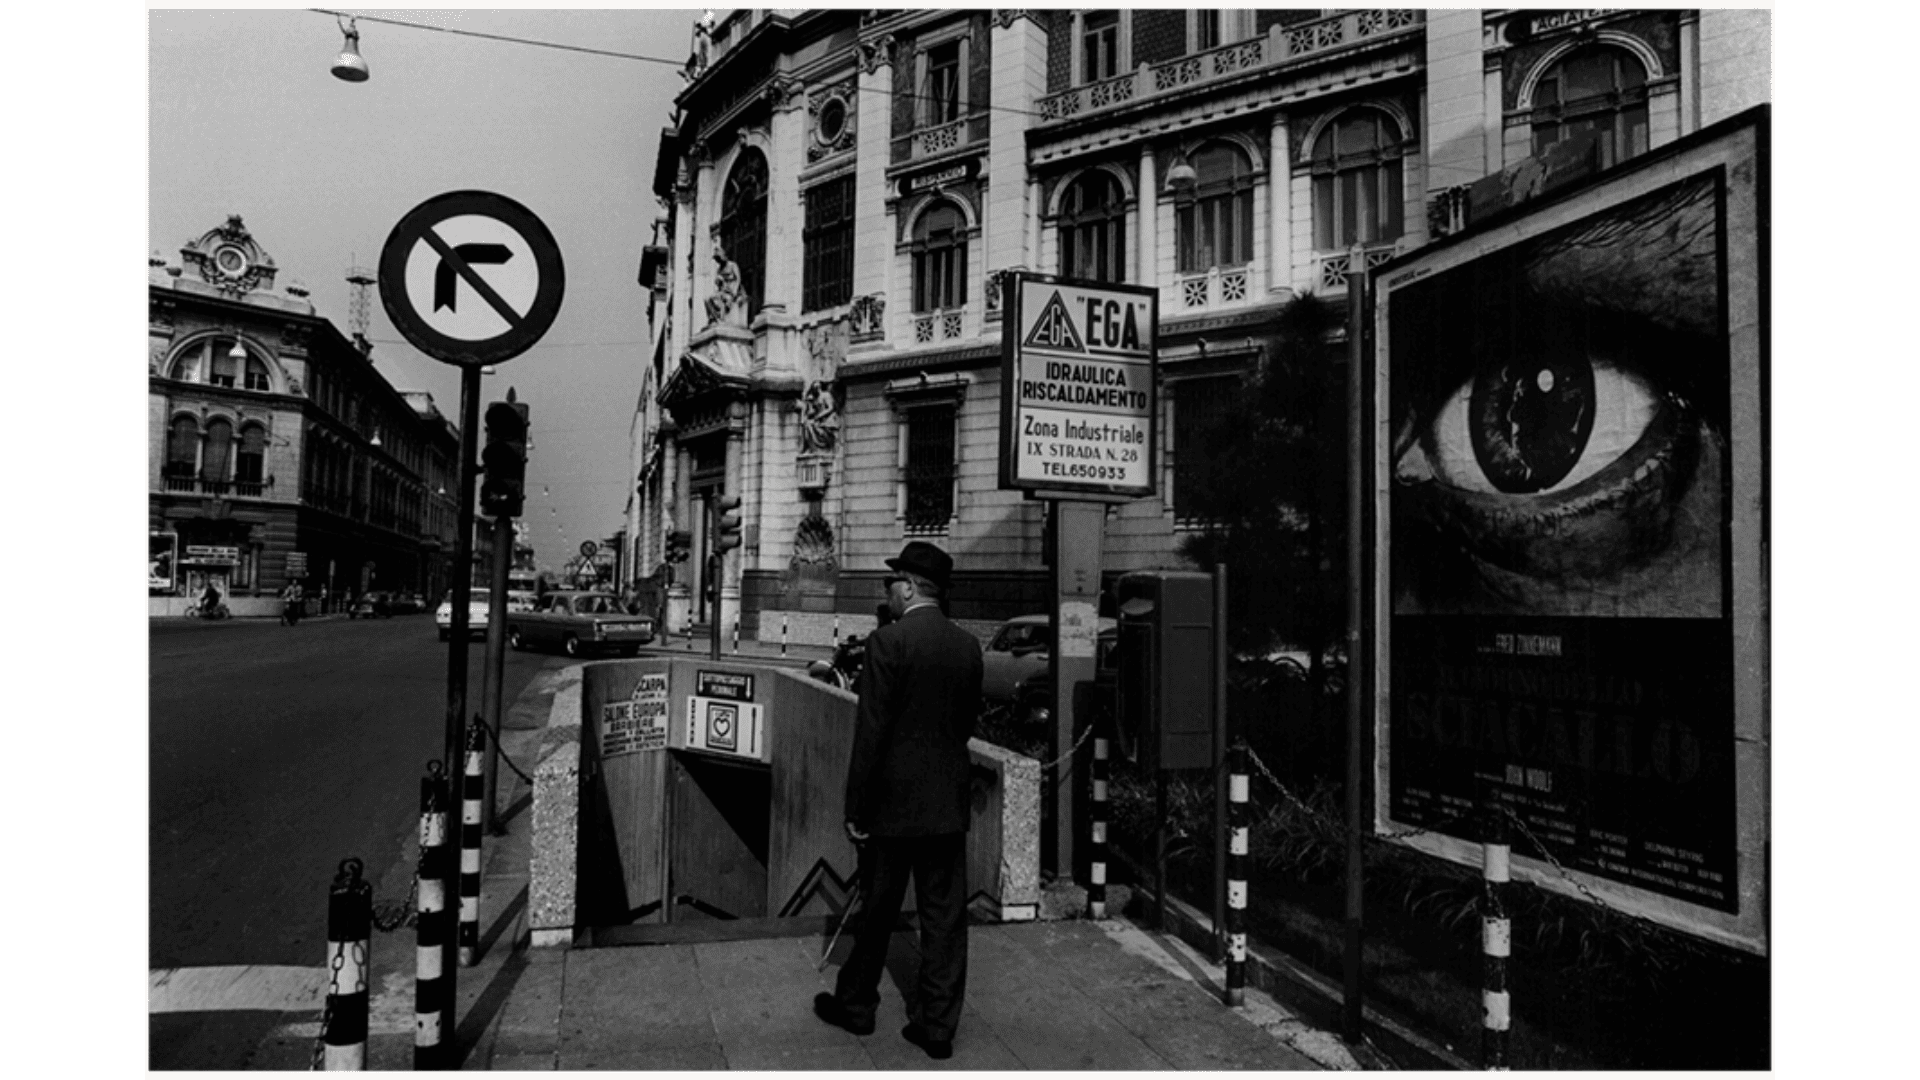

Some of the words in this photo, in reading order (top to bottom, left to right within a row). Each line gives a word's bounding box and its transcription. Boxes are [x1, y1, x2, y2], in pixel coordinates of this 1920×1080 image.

[1032, 303, 1078, 347] EGA
[1046, 362, 1126, 386] IDRAULICA
[1023, 381, 1146, 410] RISCALDAMENTO
[1024, 415, 1058, 438] Zona
[1065, 419, 1144, 445] Industriale
[1027, 442, 1043, 456] IX
[1049, 443, 1102, 460] STRADA
[1106, 448, 1118, 461] N.
[1121, 449, 1138, 462] 28
[1495, 633, 1514, 654] FRED
[604, 705, 630, 723] SALONE
[634, 702, 665, 718] EUROPA
[1644, 841, 1676, 858] DELPHINE
